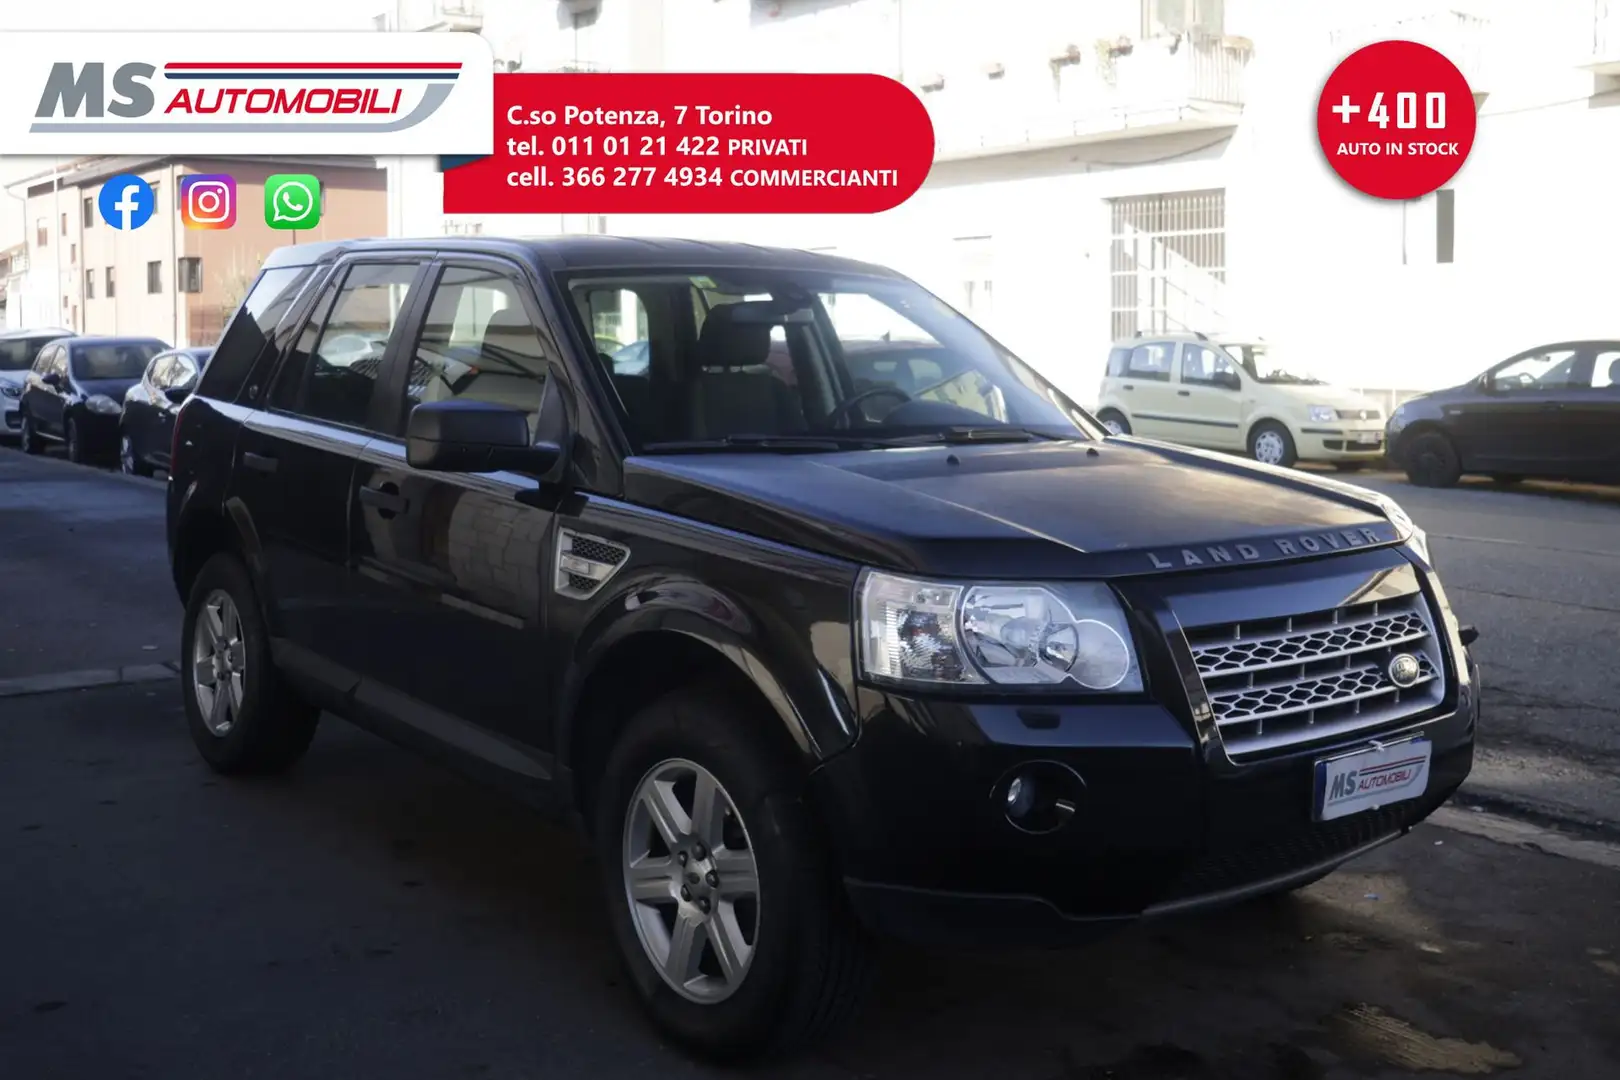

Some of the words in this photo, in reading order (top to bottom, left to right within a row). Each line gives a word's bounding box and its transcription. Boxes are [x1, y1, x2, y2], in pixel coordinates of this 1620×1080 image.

[1147, 543, 1259, 569] LAND
[1274, 527, 1381, 555] ROVER
[1328, 770, 1358, 801] MS
